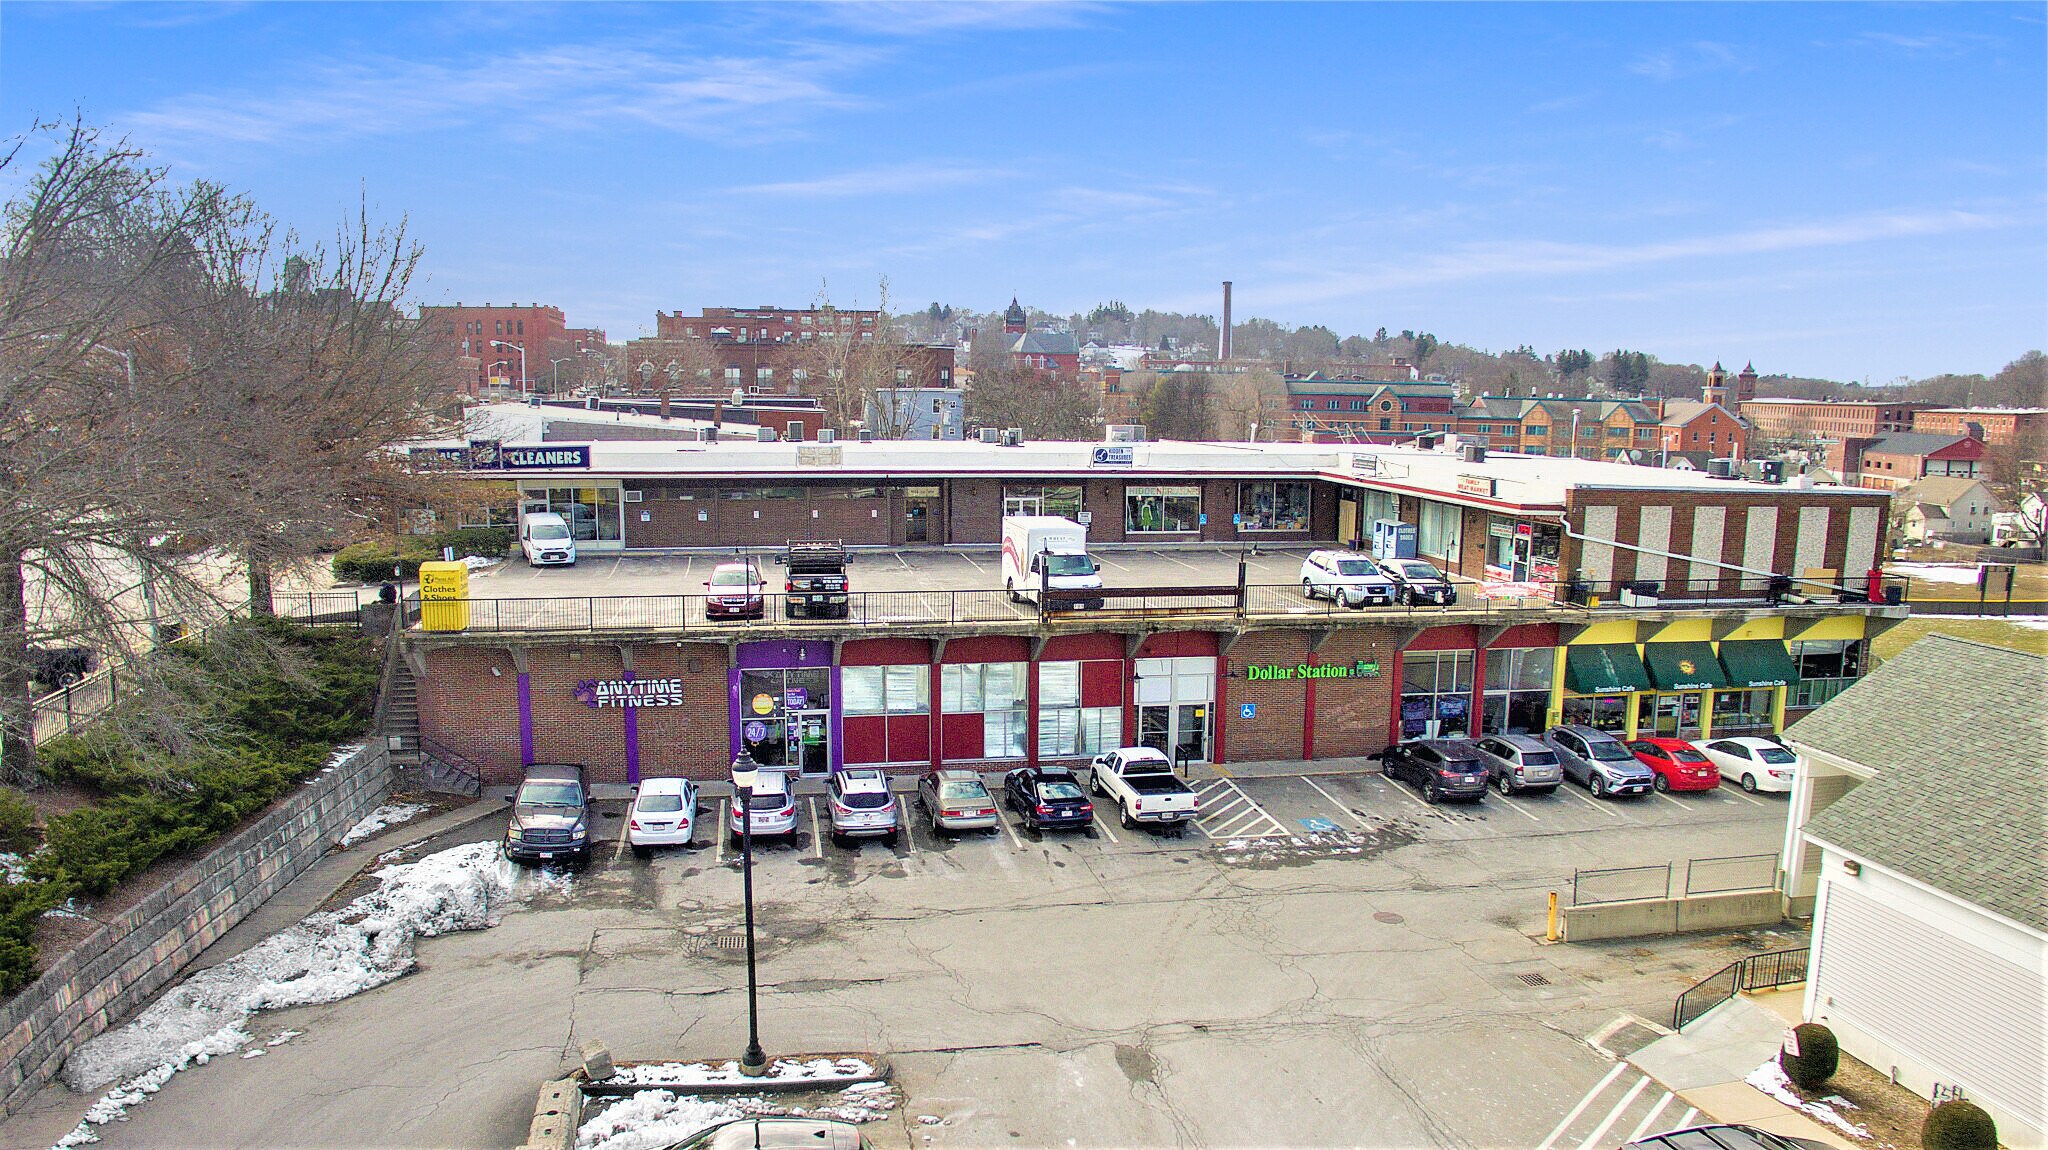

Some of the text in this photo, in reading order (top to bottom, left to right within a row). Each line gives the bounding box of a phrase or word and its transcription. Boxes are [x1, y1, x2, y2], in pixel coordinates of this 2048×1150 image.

[511, 451, 582, 466] CLEANERS
[1248, 663, 1347, 680] Dollar Station
[596, 678, 682, 696] ANYTIME
[598, 694, 683, 708] FITNESS
[748, 728, 765, 738] 24/7
